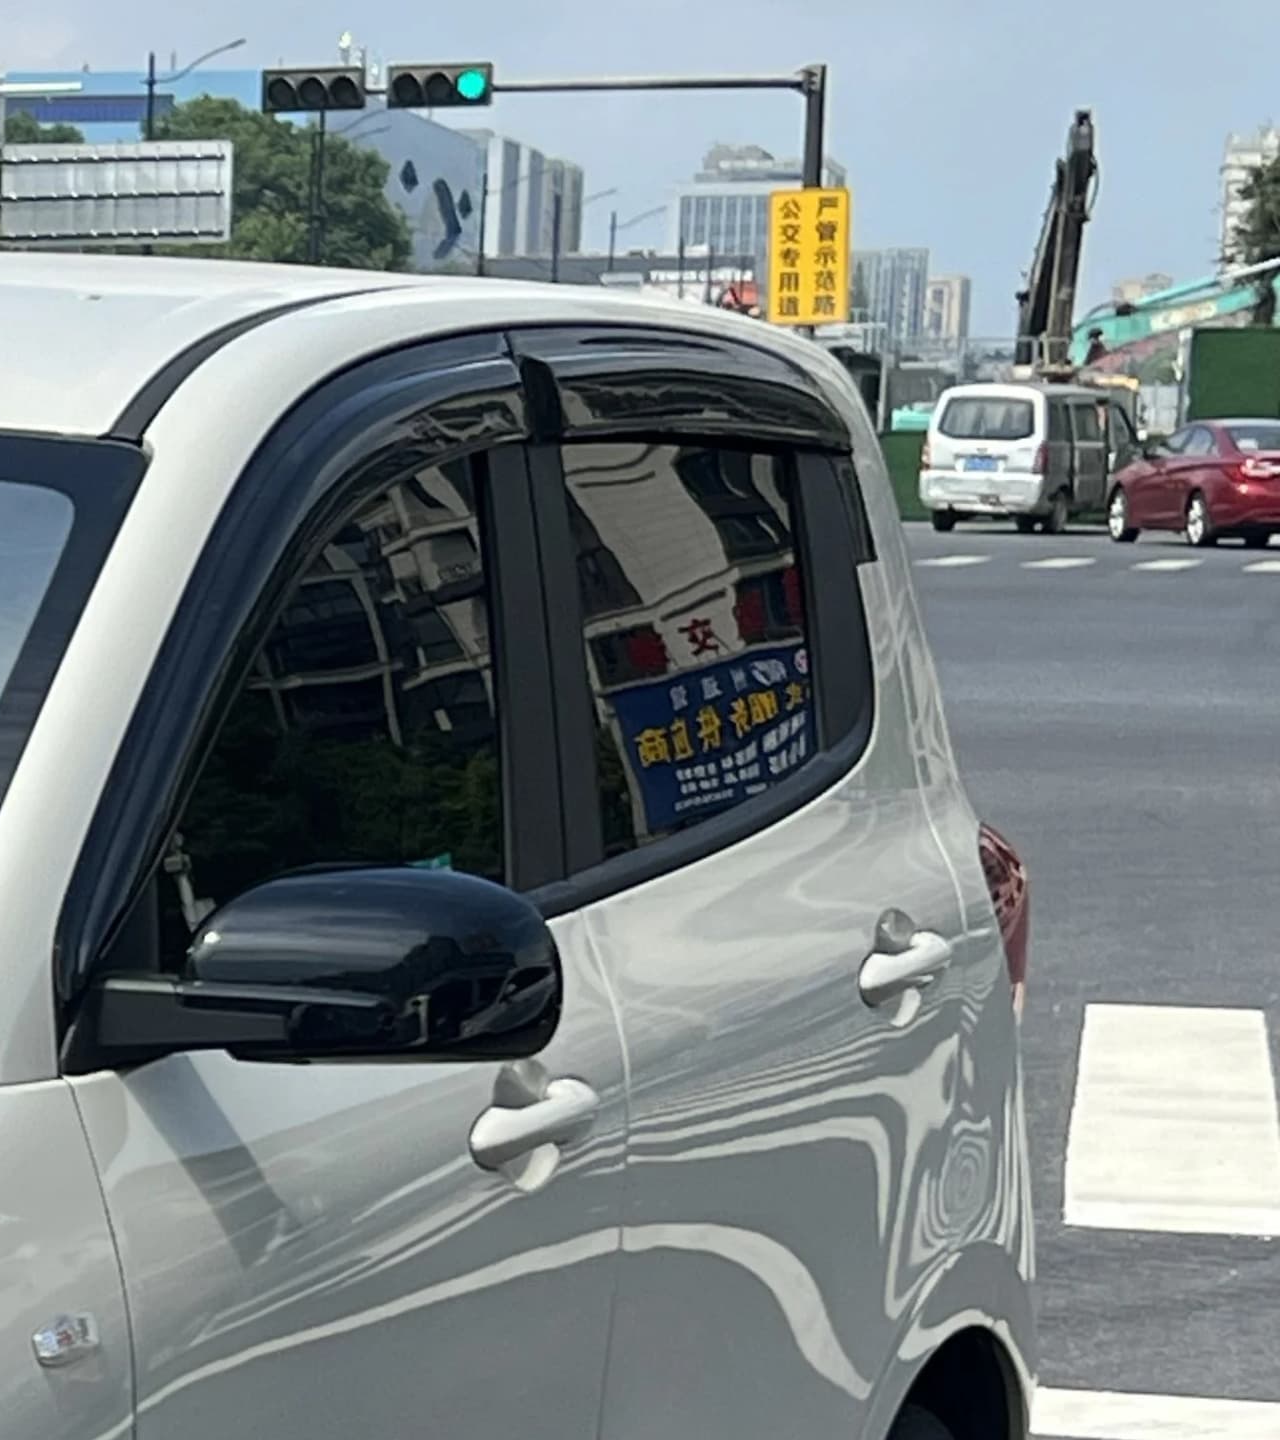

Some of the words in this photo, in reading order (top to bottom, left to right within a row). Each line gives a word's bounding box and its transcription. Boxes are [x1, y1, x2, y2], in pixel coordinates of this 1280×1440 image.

[778, 197, 801, 317] 公交专用道
[811, 196, 840, 316] 严管示范路
